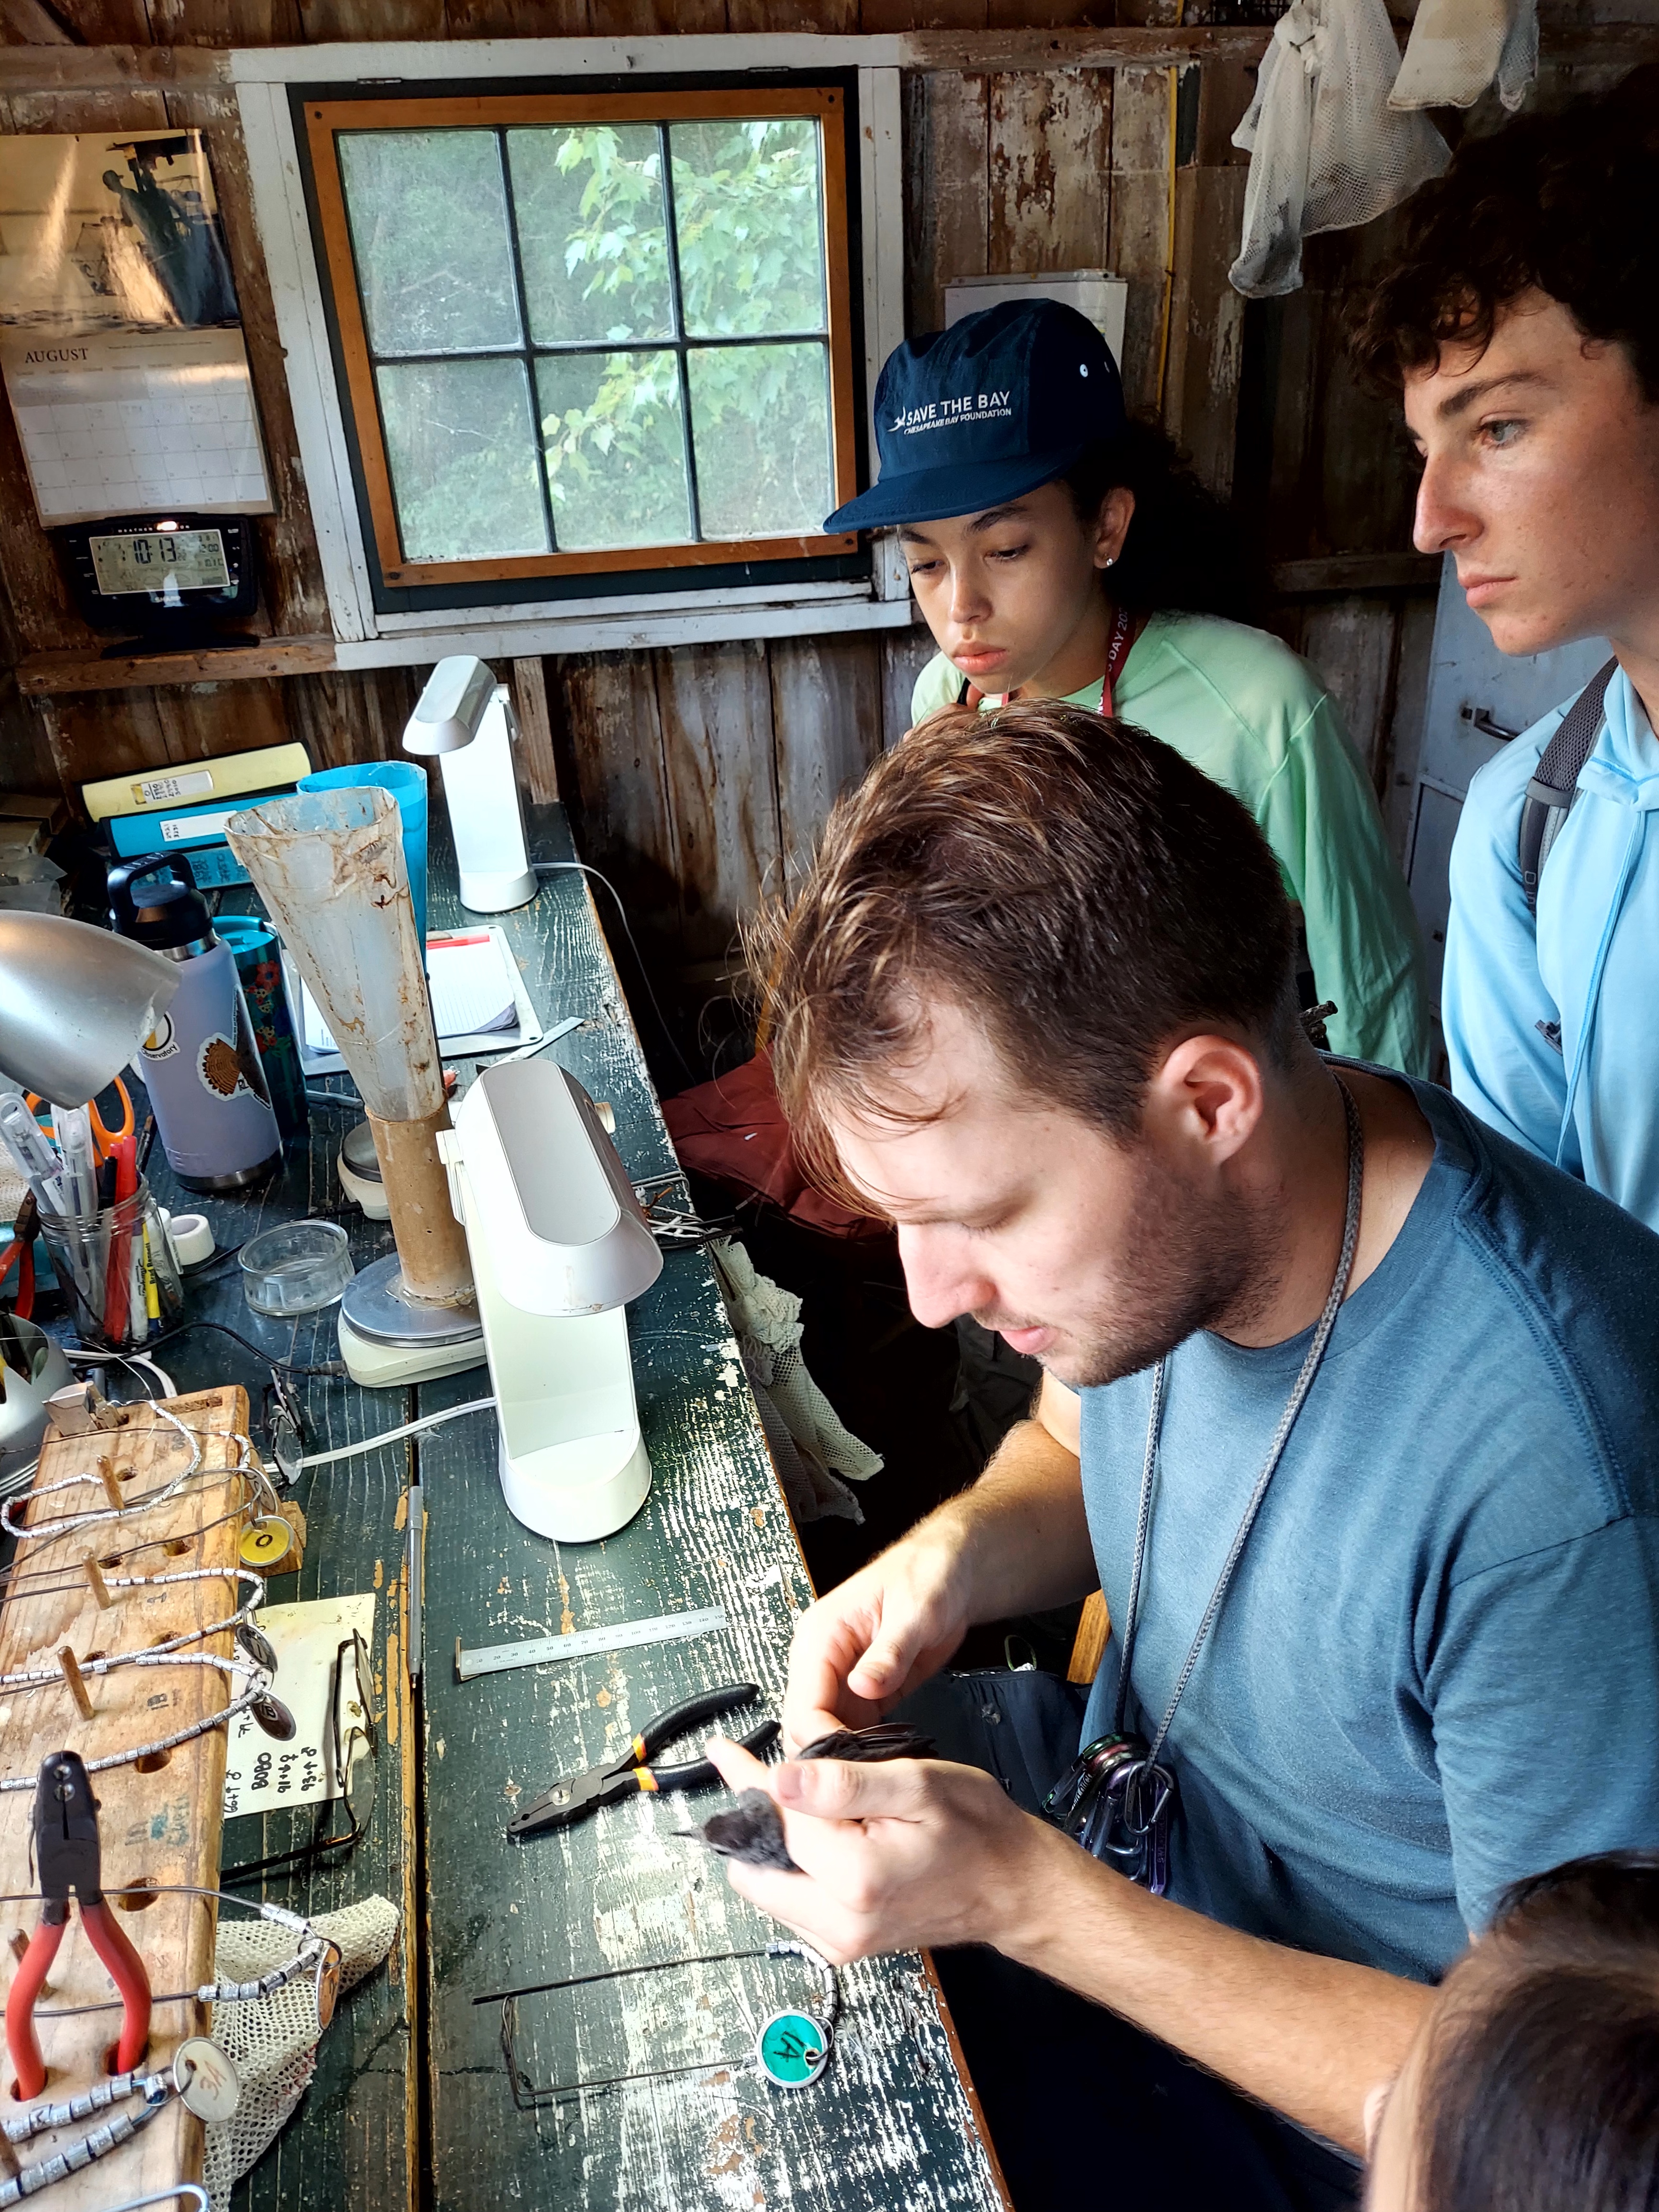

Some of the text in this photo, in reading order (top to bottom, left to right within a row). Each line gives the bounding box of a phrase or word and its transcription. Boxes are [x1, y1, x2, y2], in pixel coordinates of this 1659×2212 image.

[25, 348, 88, 364] AUGUST
[906, 390, 1010, 426] SAVE THE BAY
[945, 415, 959, 426] BAY
[960, 408, 1012, 422] FOUNDATION
[133, 537, 177, 564] 10:13
[1108, 630, 1124, 661] DAY
[251, 1752, 272, 1791] BOBO
